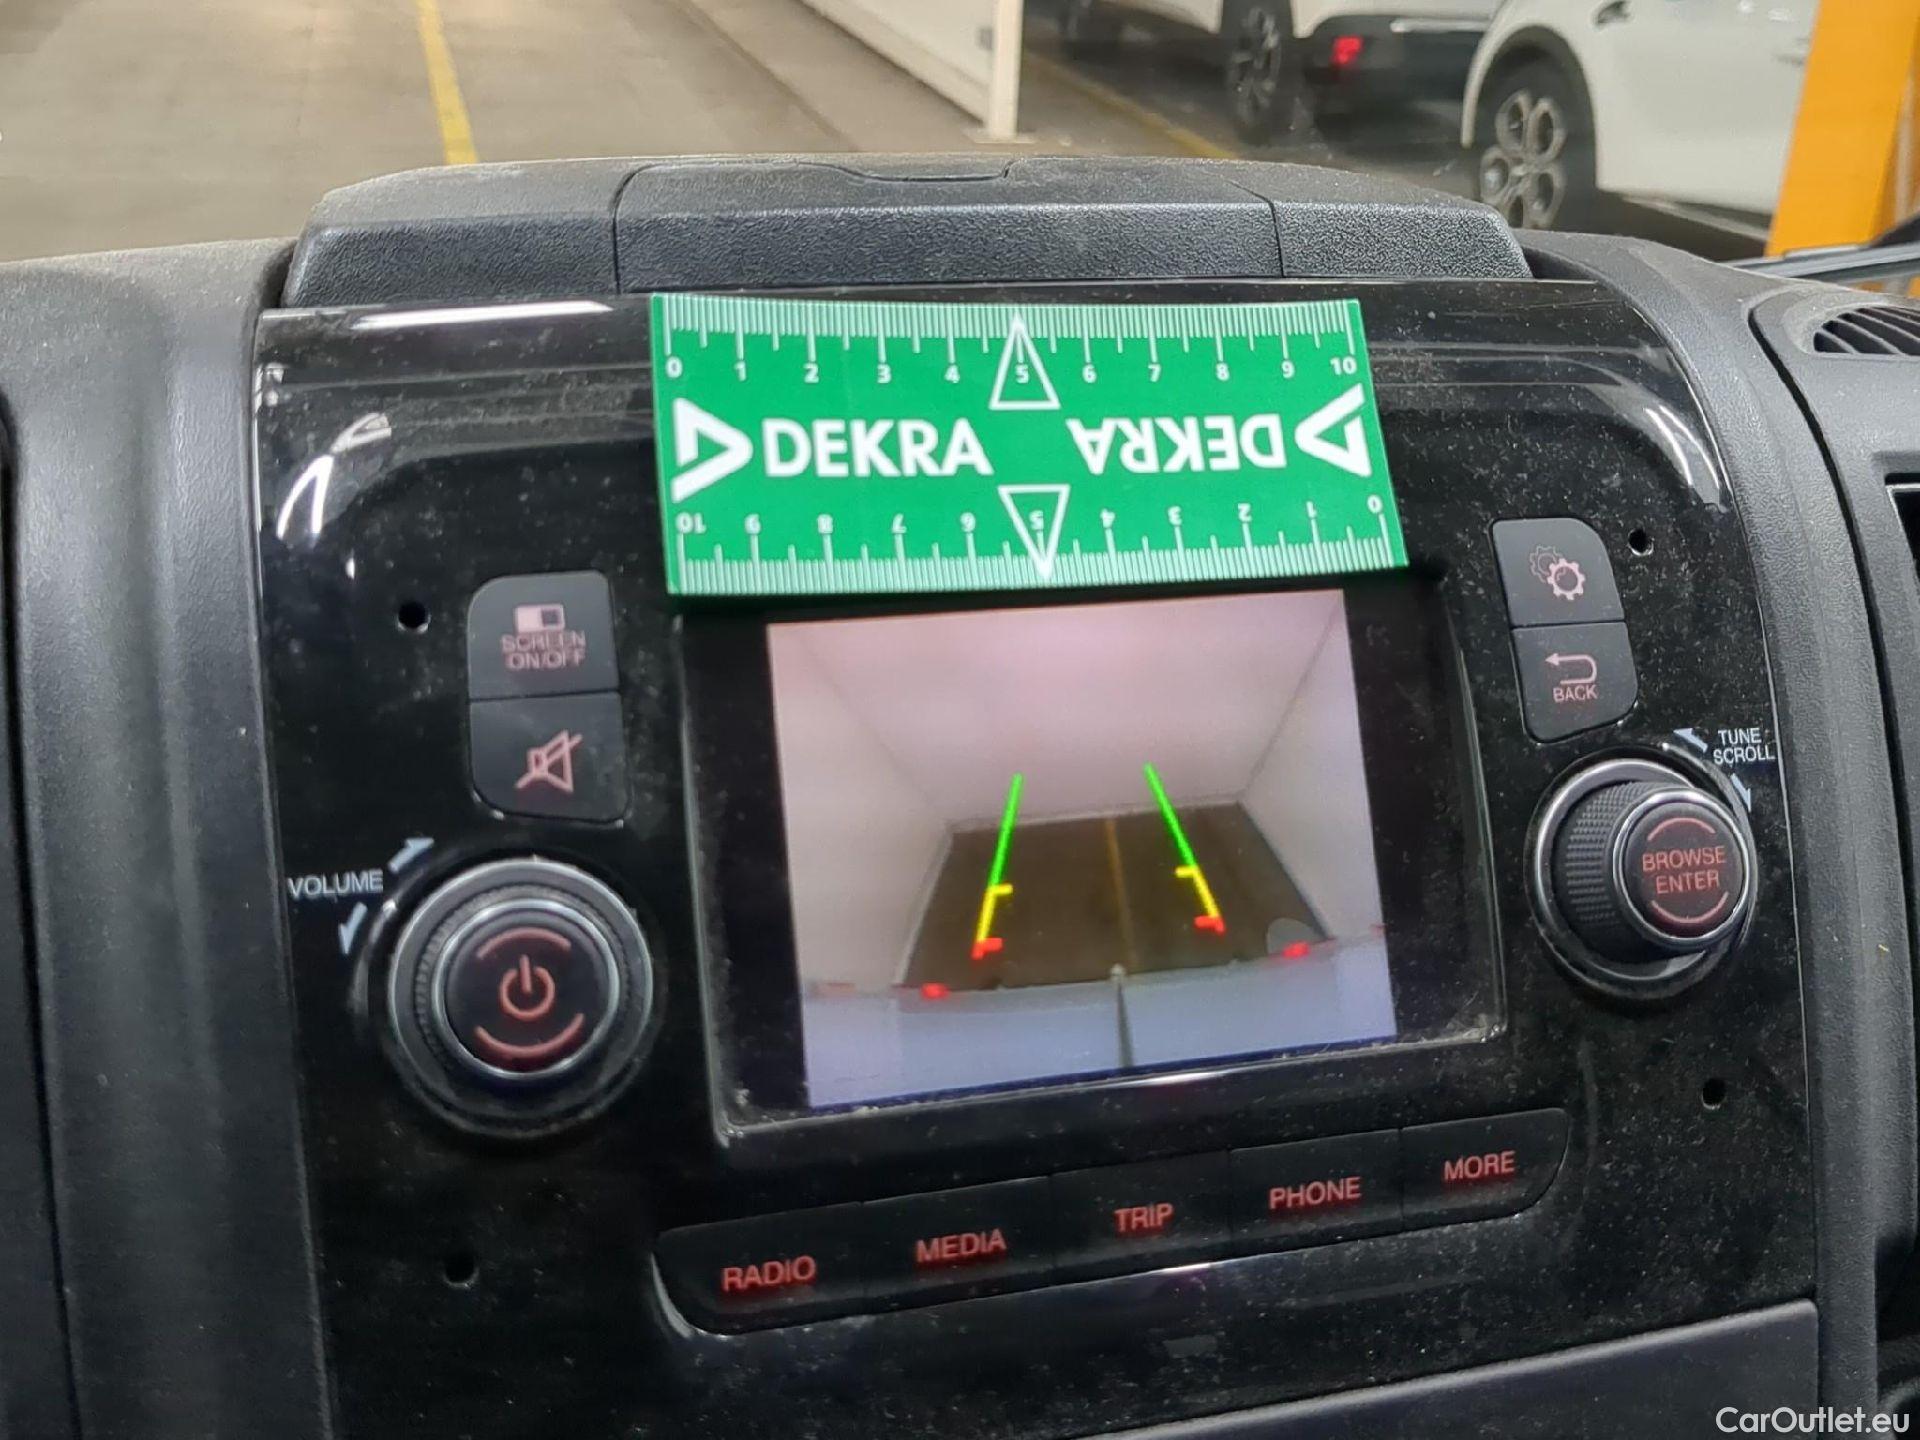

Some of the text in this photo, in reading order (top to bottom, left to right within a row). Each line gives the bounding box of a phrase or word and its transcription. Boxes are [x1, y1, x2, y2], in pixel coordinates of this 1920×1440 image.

[666, 356, 1357, 383] 0 1 2 3 4 5 6 7 8 9 10
[761, 418, 994, 478] DEKRA
[1065, 414, 1287, 475] DEKRA
[676, 494, 1382, 534] 0 1 2 3 4 5 6 7 8 9 10
[1553, 684, 1598, 702] BACK
[1718, 728, 1762, 745] TUNE
[1713, 745, 1775, 765] SCROLL
[1642, 846, 1726, 872] BROWSE
[287, 868, 384, 899] VOLUME
[1656, 870, 1720, 894] ENTER
[1444, 1150, 1516, 1181] MORE
[1268, 1176, 1362, 1210] PHONE
[1113, 1203, 1174, 1233] TRIP
[915, 1228, 1007, 1263] MEDIA
[721, 1255, 817, 1292] RADIO
